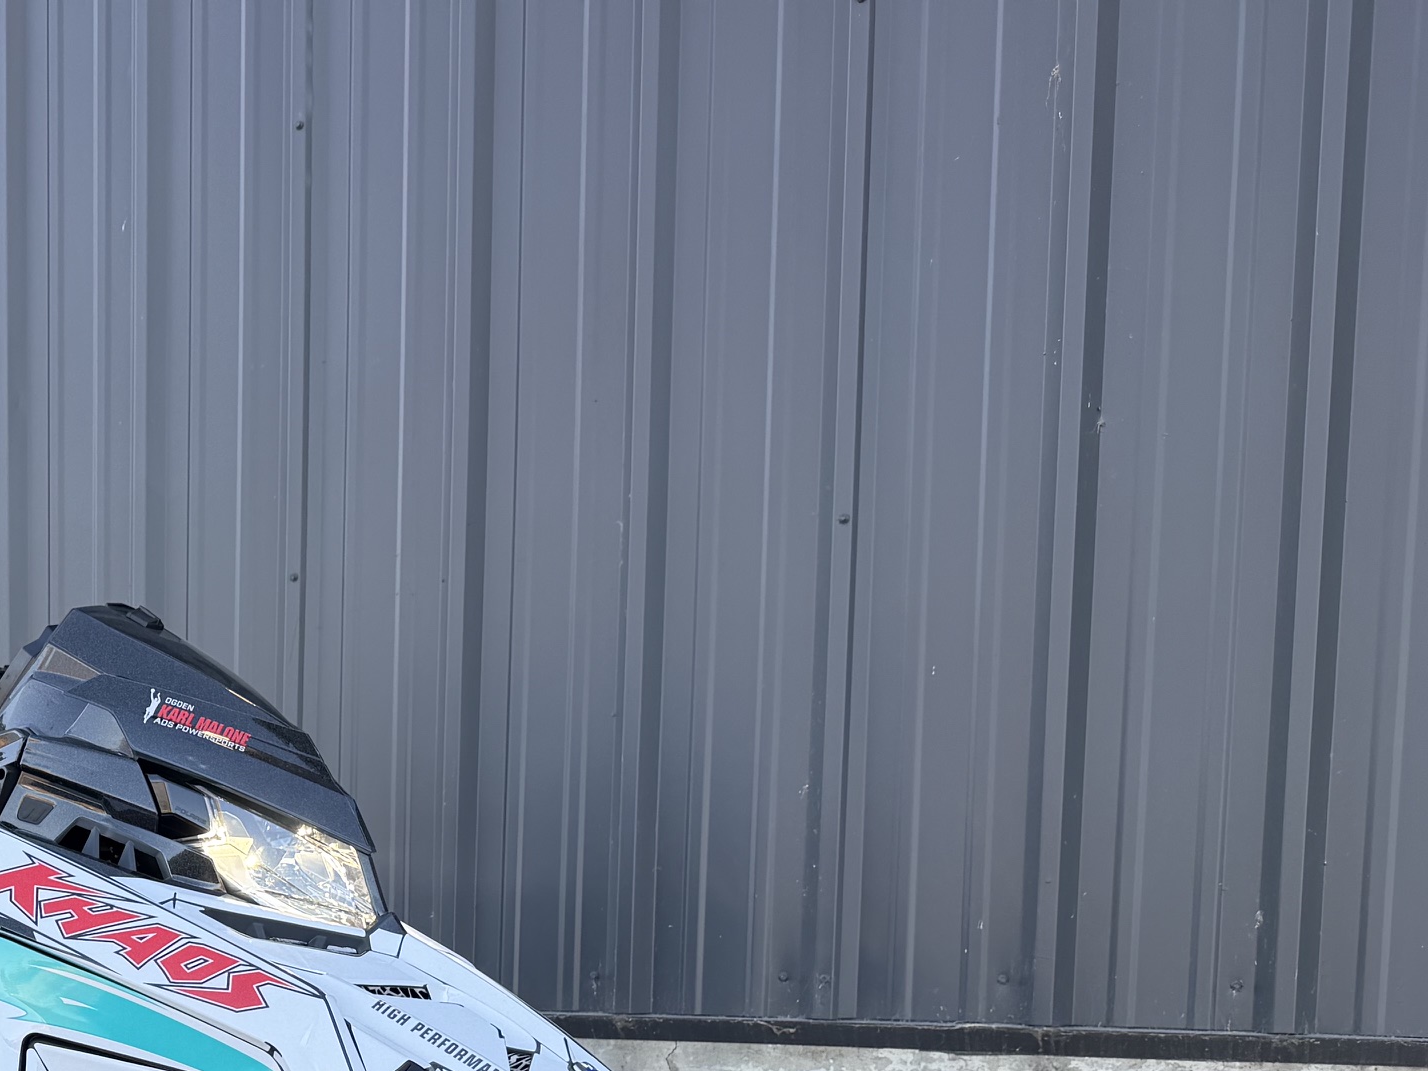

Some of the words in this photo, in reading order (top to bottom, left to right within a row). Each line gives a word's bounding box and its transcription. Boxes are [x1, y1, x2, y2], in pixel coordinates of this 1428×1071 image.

[165, 697, 194, 711] OGDEN
[153, 717, 174, 728] ADS
[175, 724, 246, 752] POWERSPORTS
[158, 704, 195, 727] KARL
[195, 716, 251, 746] MALONE
[371, 999, 412, 1026] HIGH
